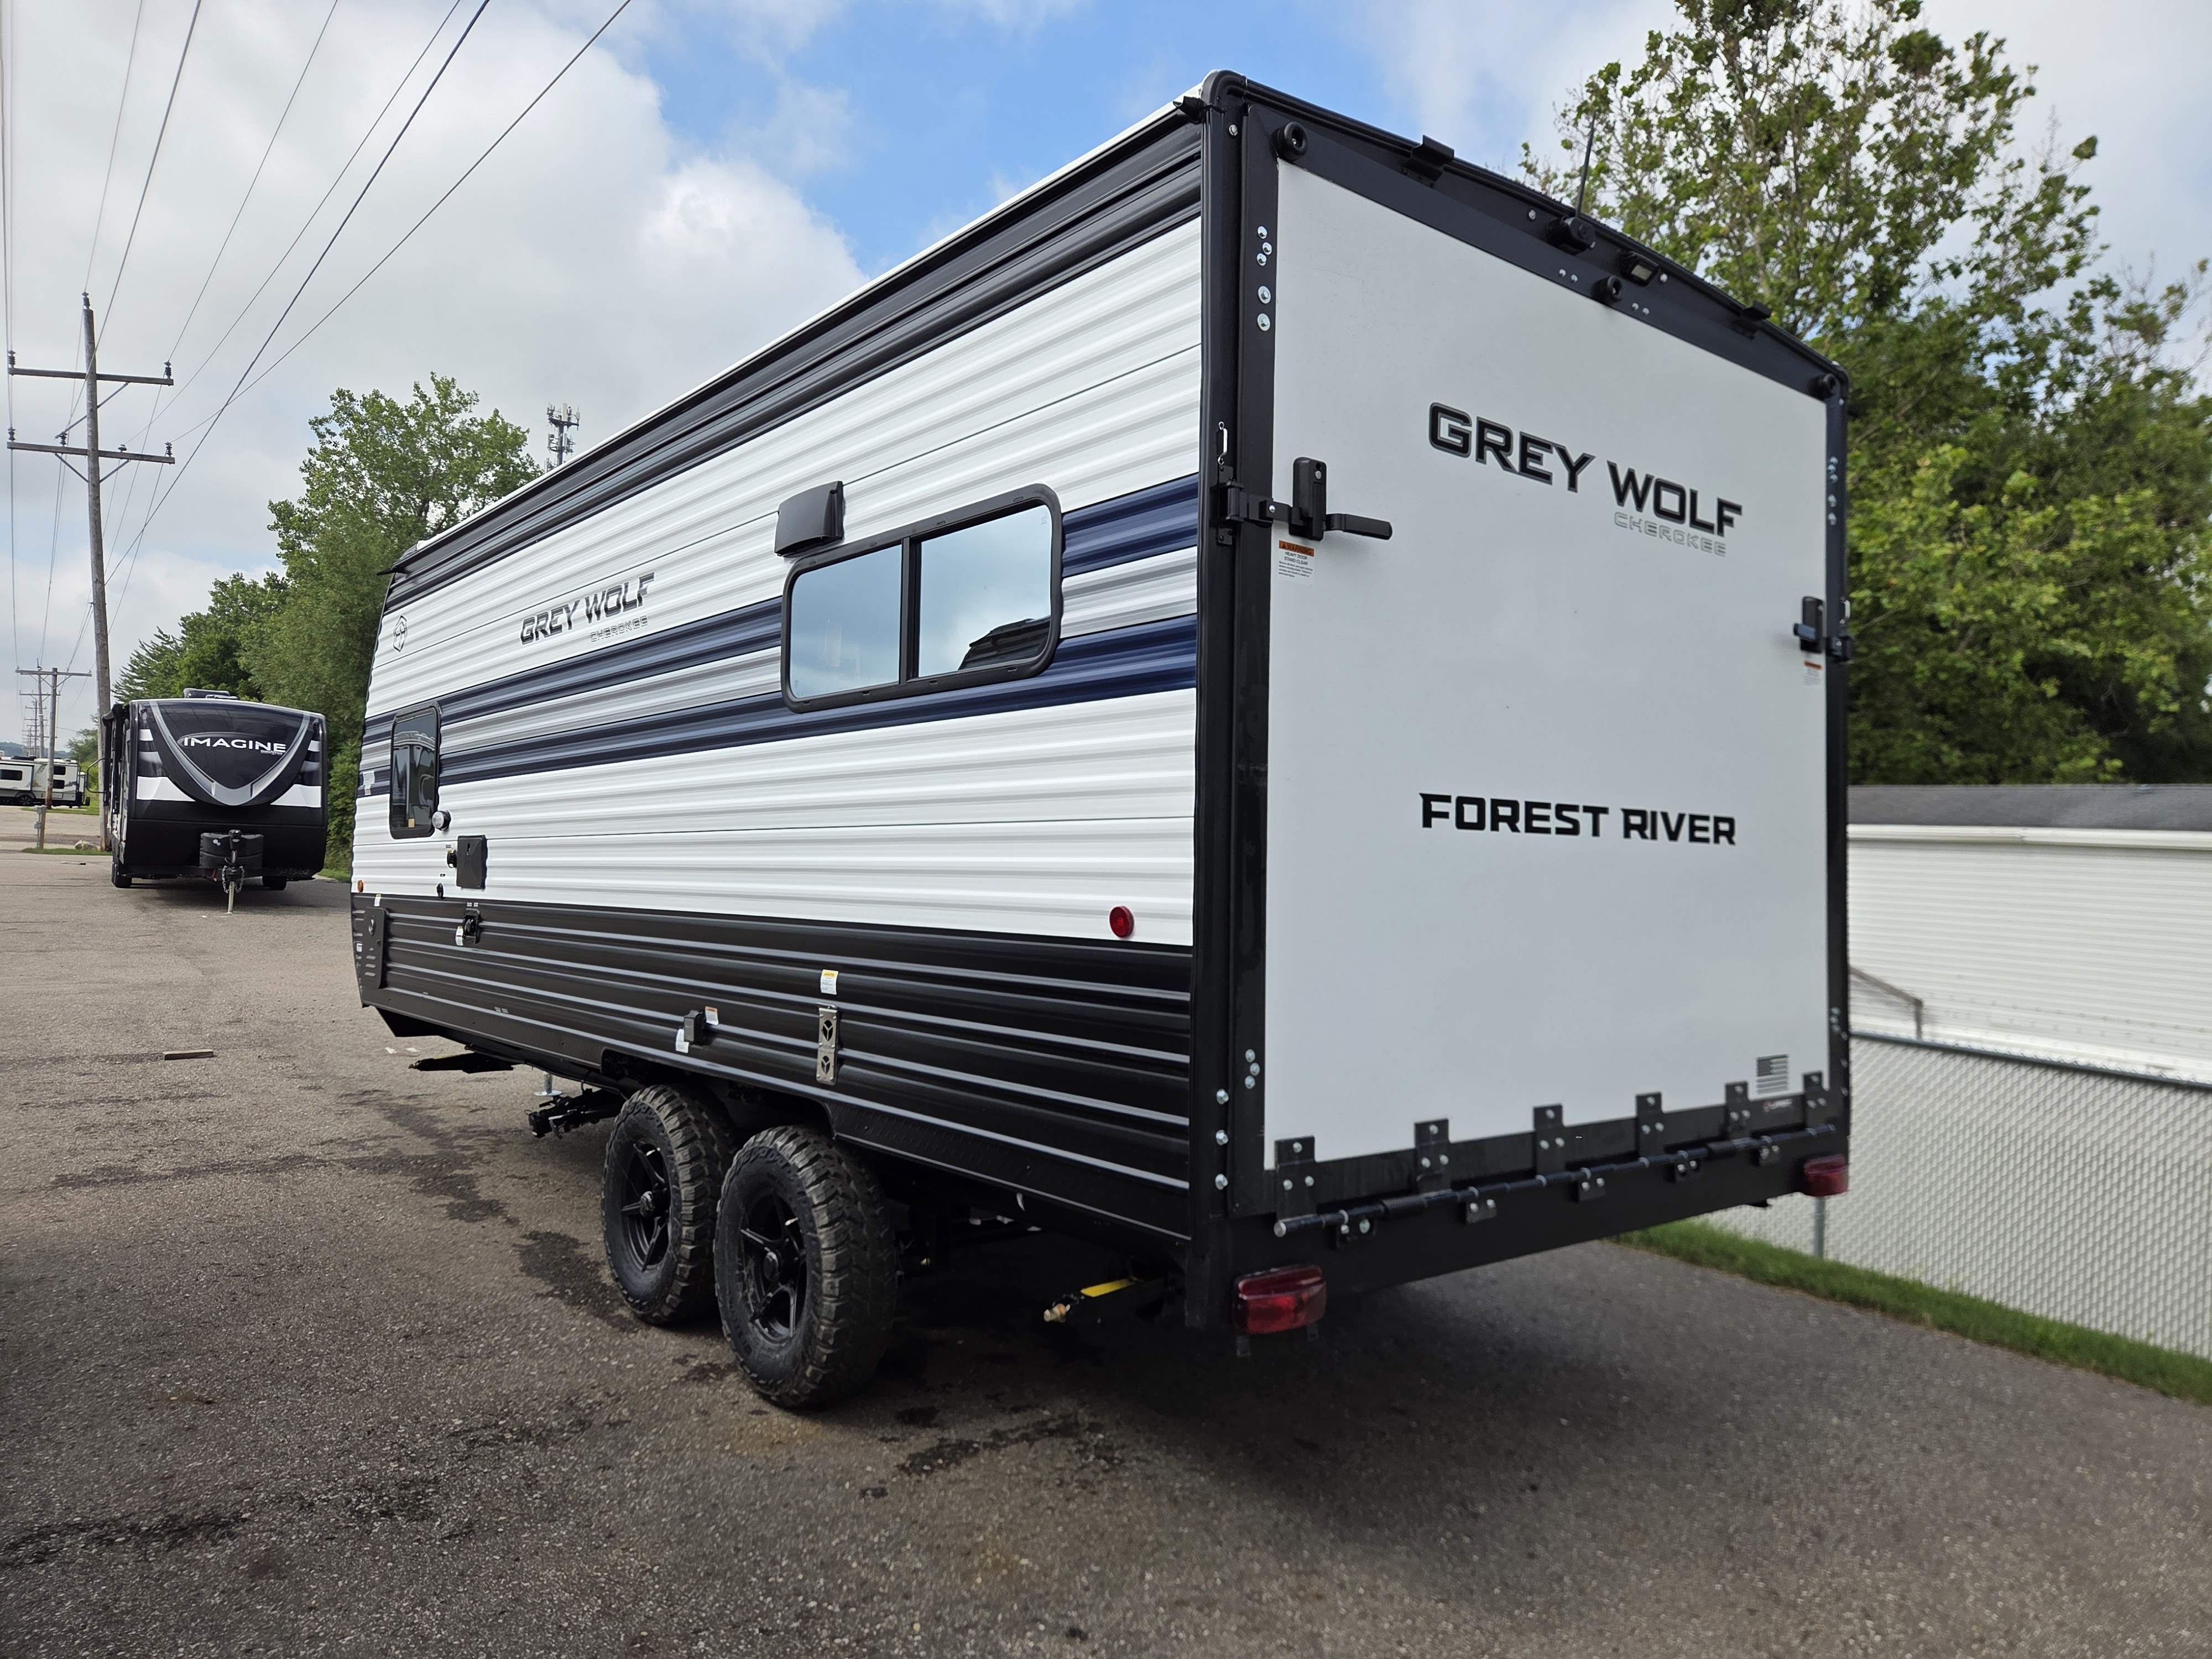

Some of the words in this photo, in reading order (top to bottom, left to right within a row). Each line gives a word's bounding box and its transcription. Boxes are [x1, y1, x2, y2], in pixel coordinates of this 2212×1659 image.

[1429, 402, 1595, 493] GREY
[1607, 460, 1743, 537] WOLF
[1287, 543, 1311, 555] WARNING
[1614, 512, 1726, 557] CHEROKEE
[520, 599, 580, 645] GREY
[585, 572, 655, 624] WOLF
[590, 615, 648, 642] CHEROKEE
[184, 737, 286, 753] IMAGINE
[1419, 792, 1609, 837] FOREST
[1621, 807, 1736, 846] RIVER
